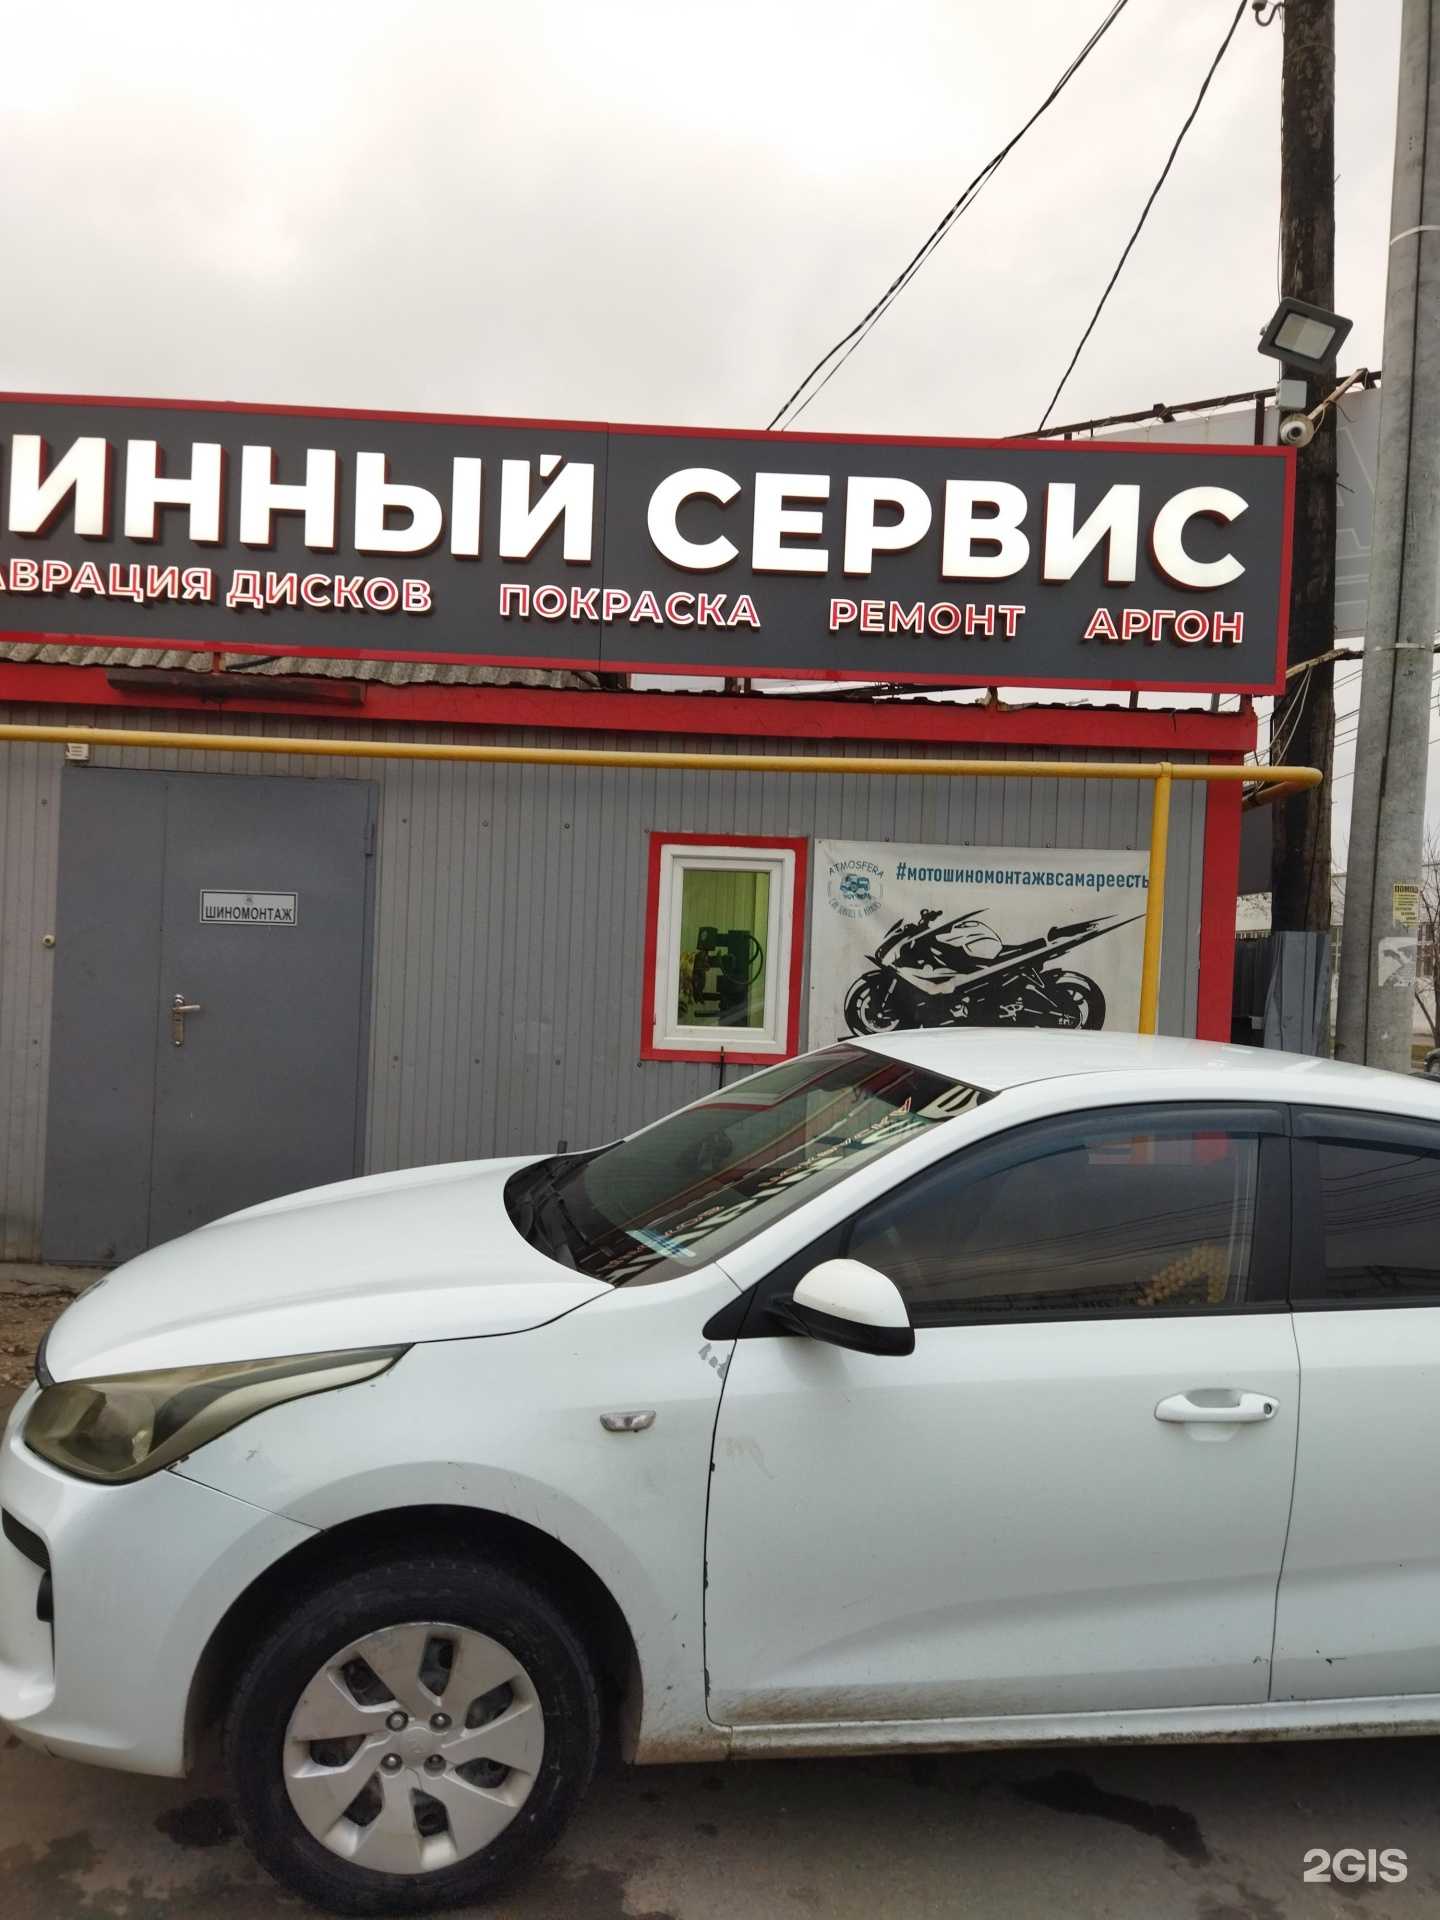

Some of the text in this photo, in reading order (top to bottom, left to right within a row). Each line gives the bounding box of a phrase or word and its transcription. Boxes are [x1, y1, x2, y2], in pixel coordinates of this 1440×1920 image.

[8, 434, 1250, 589] ИННЫЙ СЕРВИС
[0, 558, 1245, 645] ВРАЦИЯ ДИСКОВ ПОКРАСКА РЕМОНТ АРГОН
[828, 860, 885, 878] ATMOSFERA
[895, 861, 1150, 893] #мотошиномонтажвсамареесть
[205, 906, 293, 921] ШИНОМОНТАЖ
